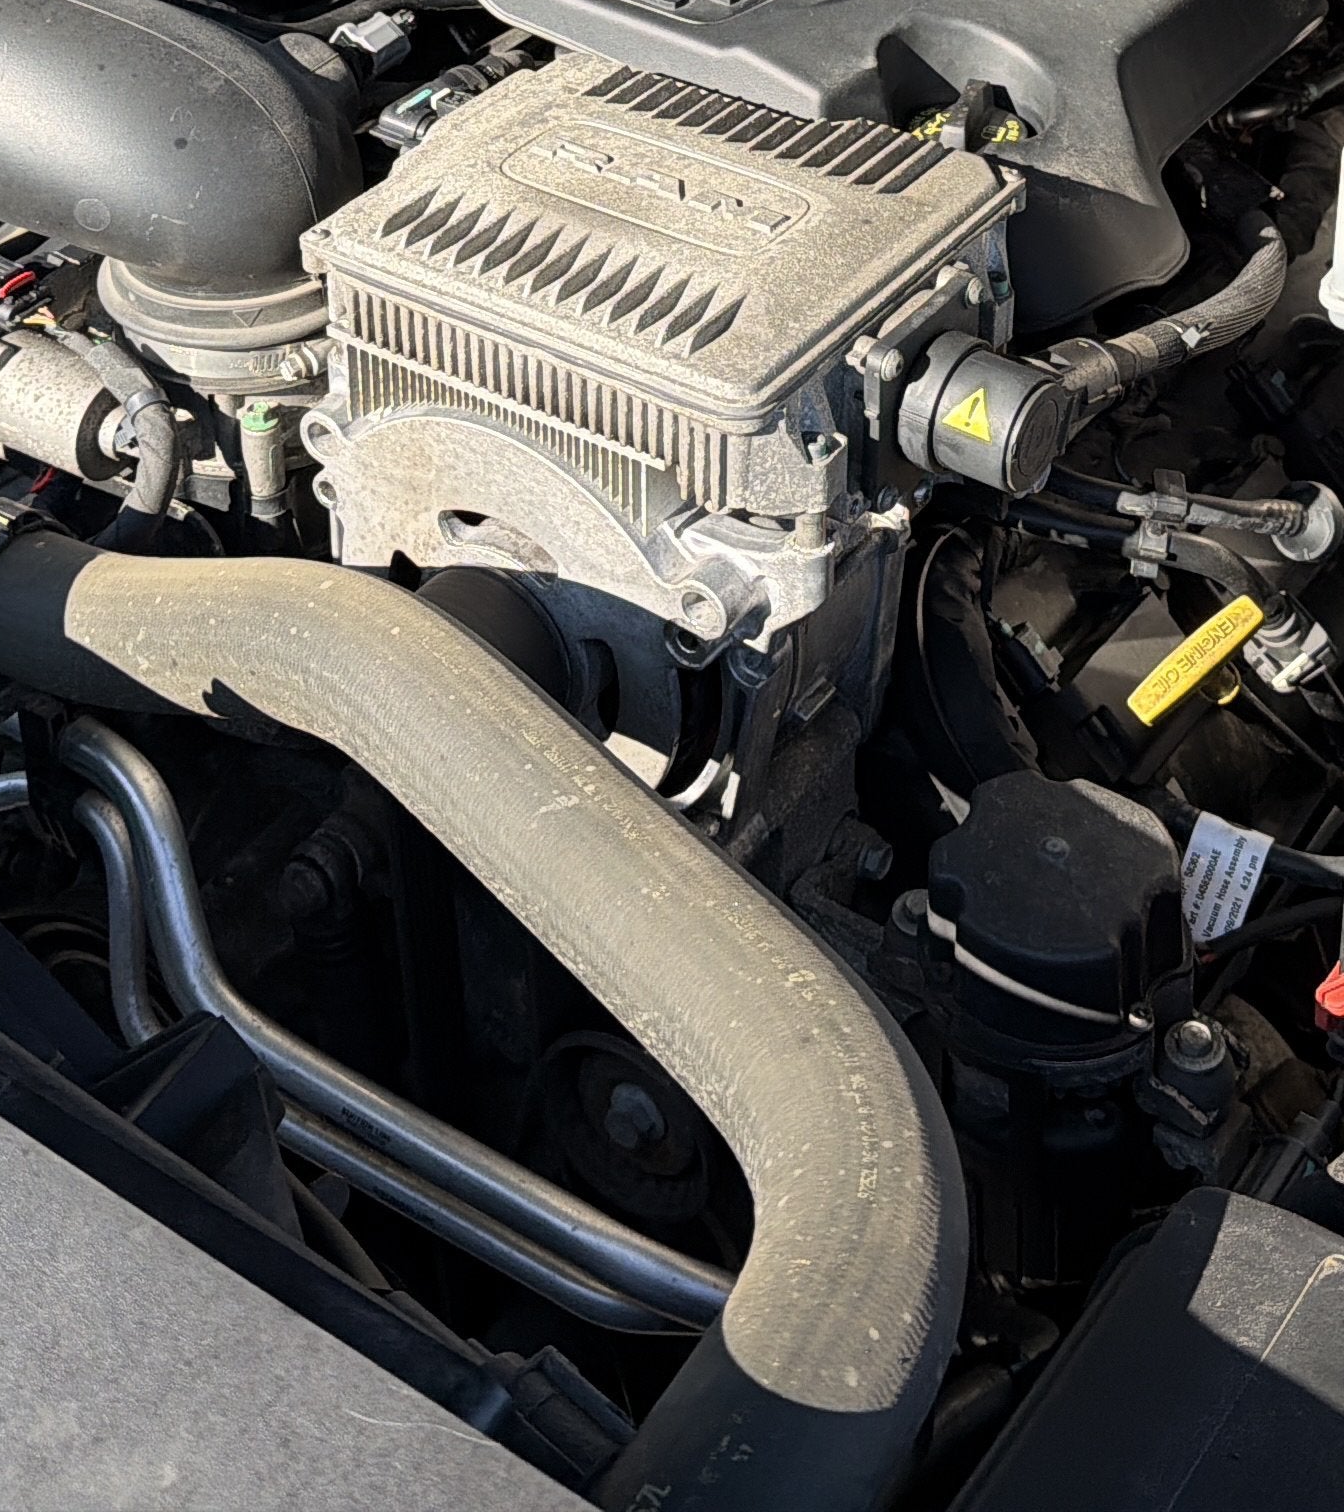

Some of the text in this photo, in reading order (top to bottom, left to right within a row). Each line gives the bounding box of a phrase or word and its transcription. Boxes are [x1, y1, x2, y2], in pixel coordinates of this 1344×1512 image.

[529, 136, 792, 234] RAM
[1152, 615, 1236, 694] ENGINE OIL
[1201, 834, 1247, 938] Vacuum Hose Assembly
[1249, 854, 1259, 871] pm
